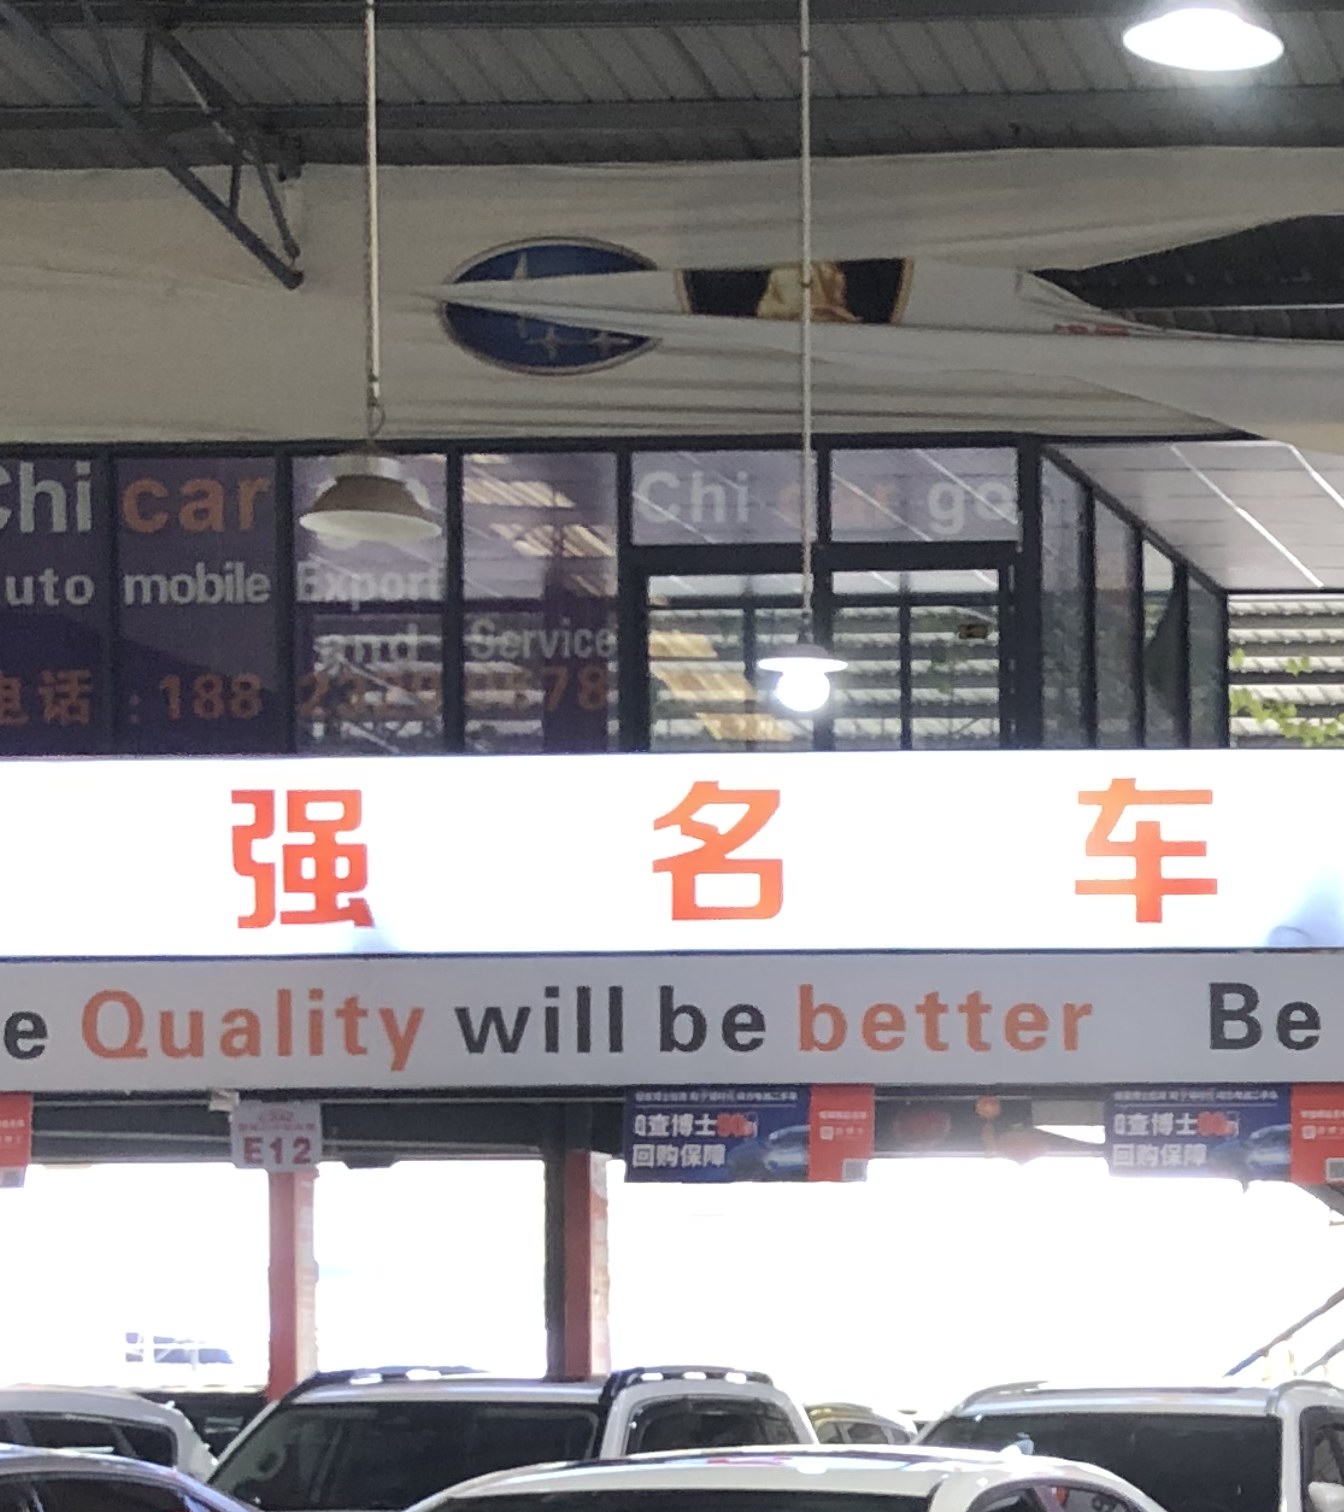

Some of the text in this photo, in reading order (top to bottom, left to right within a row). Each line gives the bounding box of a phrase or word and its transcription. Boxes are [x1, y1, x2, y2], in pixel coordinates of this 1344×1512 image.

[0, 460, 93, 533] hi
[123, 561, 272, 605] mobile
[296, 560, 446, 611] Export
[470, 616, 617, 660] Service
[82, 989, 425, 1072] Quality
[455, 985, 624, 1054] will
[659, 985, 766, 1053] be
[799, 984, 1093, 1052] better
[1209, 982, 1321, 1051] Be
[243, 1136, 312, 1165] E12
